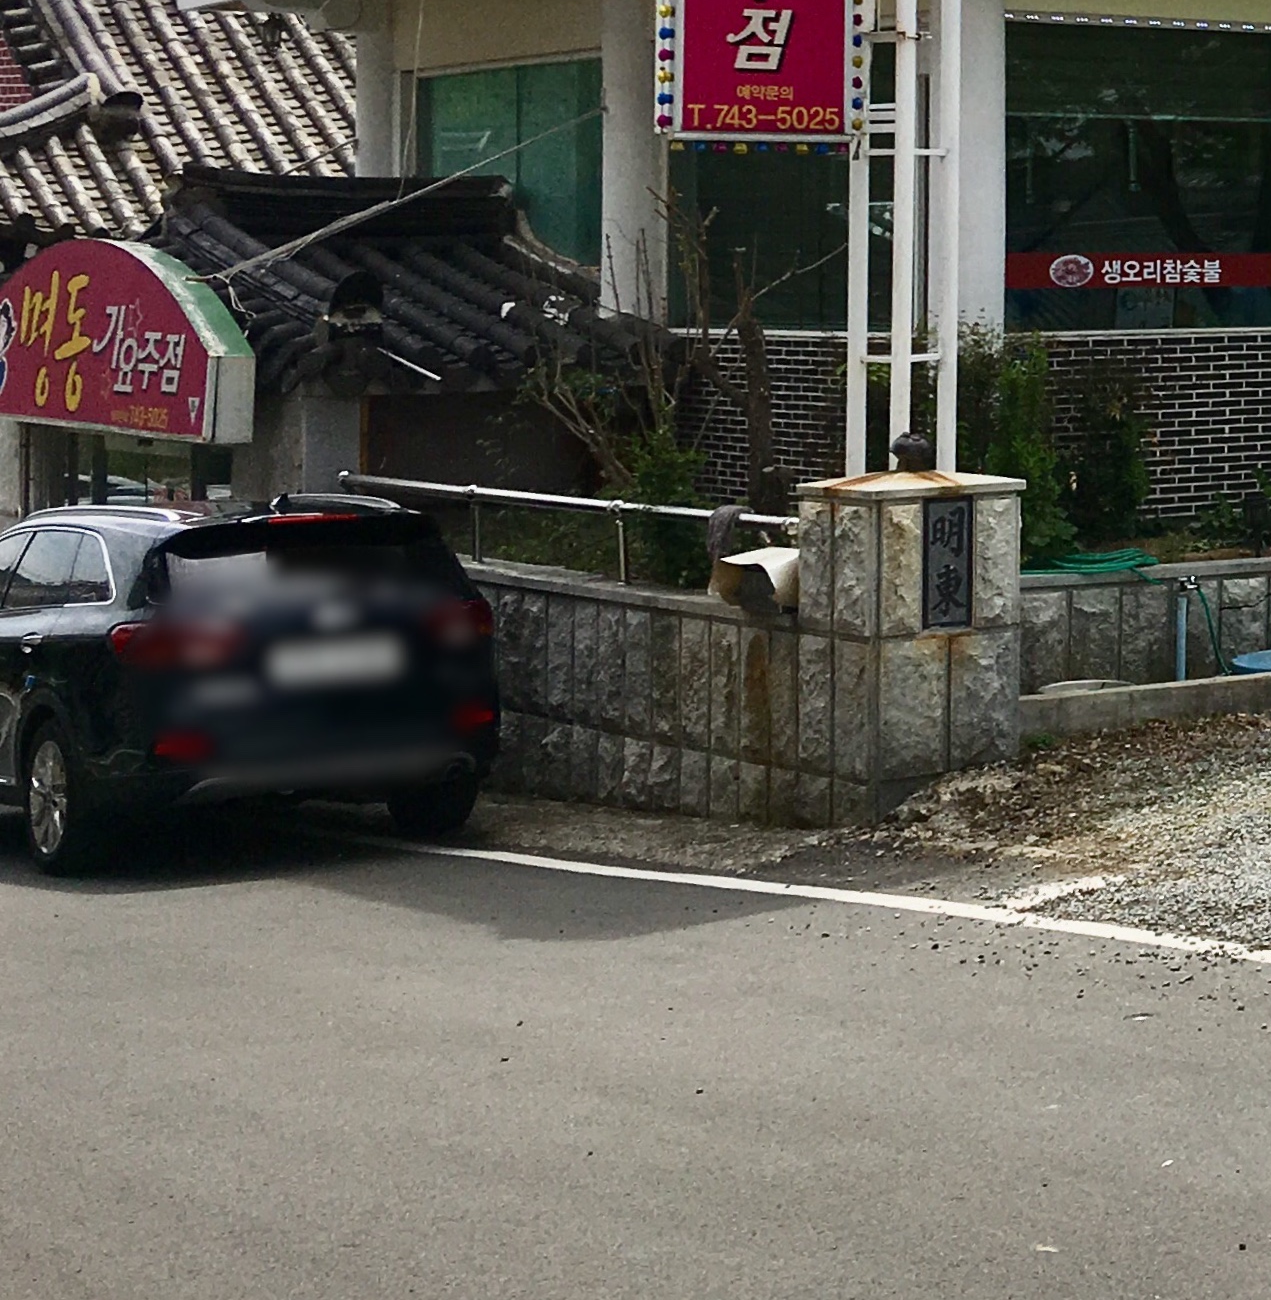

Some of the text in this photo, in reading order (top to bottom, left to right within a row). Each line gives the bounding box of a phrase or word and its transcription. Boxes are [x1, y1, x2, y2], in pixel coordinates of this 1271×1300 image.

[737, 85, 793, 100] 예약문의
[687, 104, 840, 131] T.743-5025
[1101, 259, 1222, 284] 생오리참숯불
[20, 271, 187, 412] 명동 가요주점
[930, 506, 967, 617] 明東
